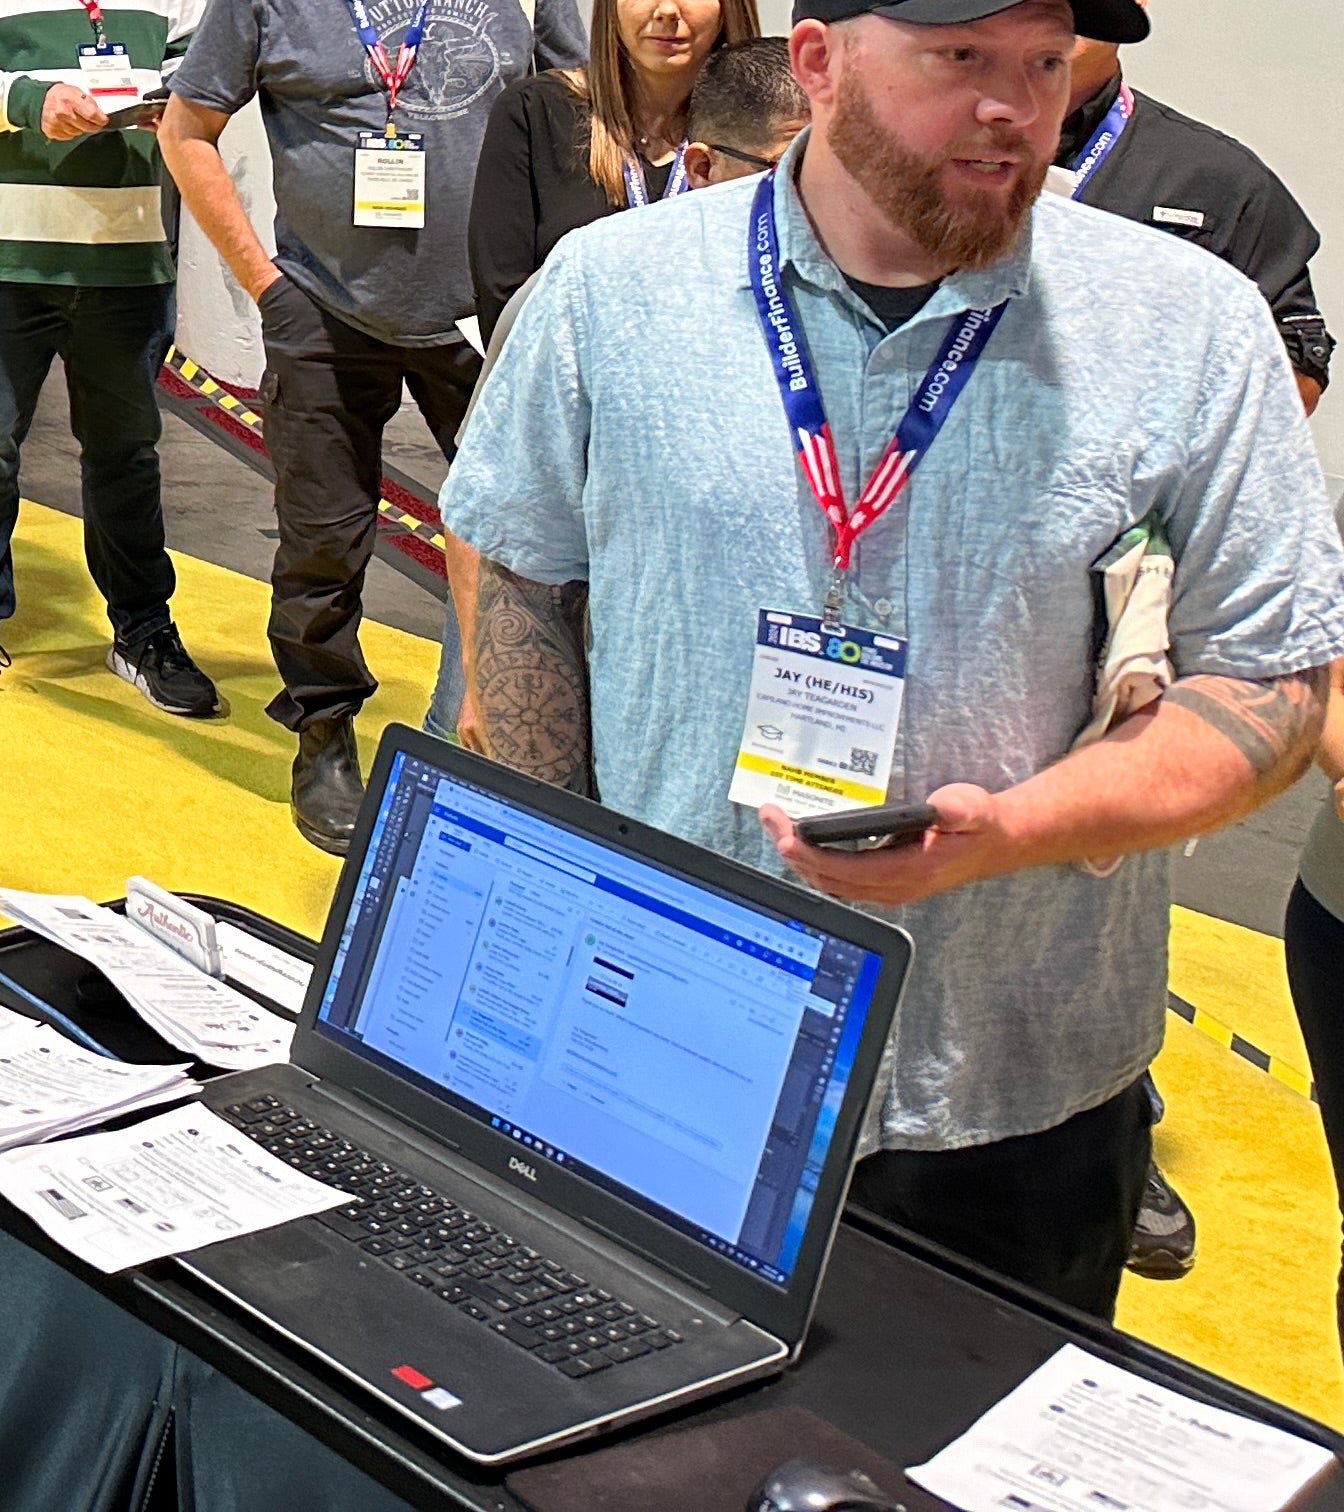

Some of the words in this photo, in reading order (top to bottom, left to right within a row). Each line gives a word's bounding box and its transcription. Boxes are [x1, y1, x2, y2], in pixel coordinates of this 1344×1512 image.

[756, 212, 809, 392] BuilderFinance.com
[779, 625, 822, 653] IBS
[773, 667, 801, 683] JAY
[803, 674, 875, 704] (HE/HIS)
[509, 1157, 537, 1181] DELL
